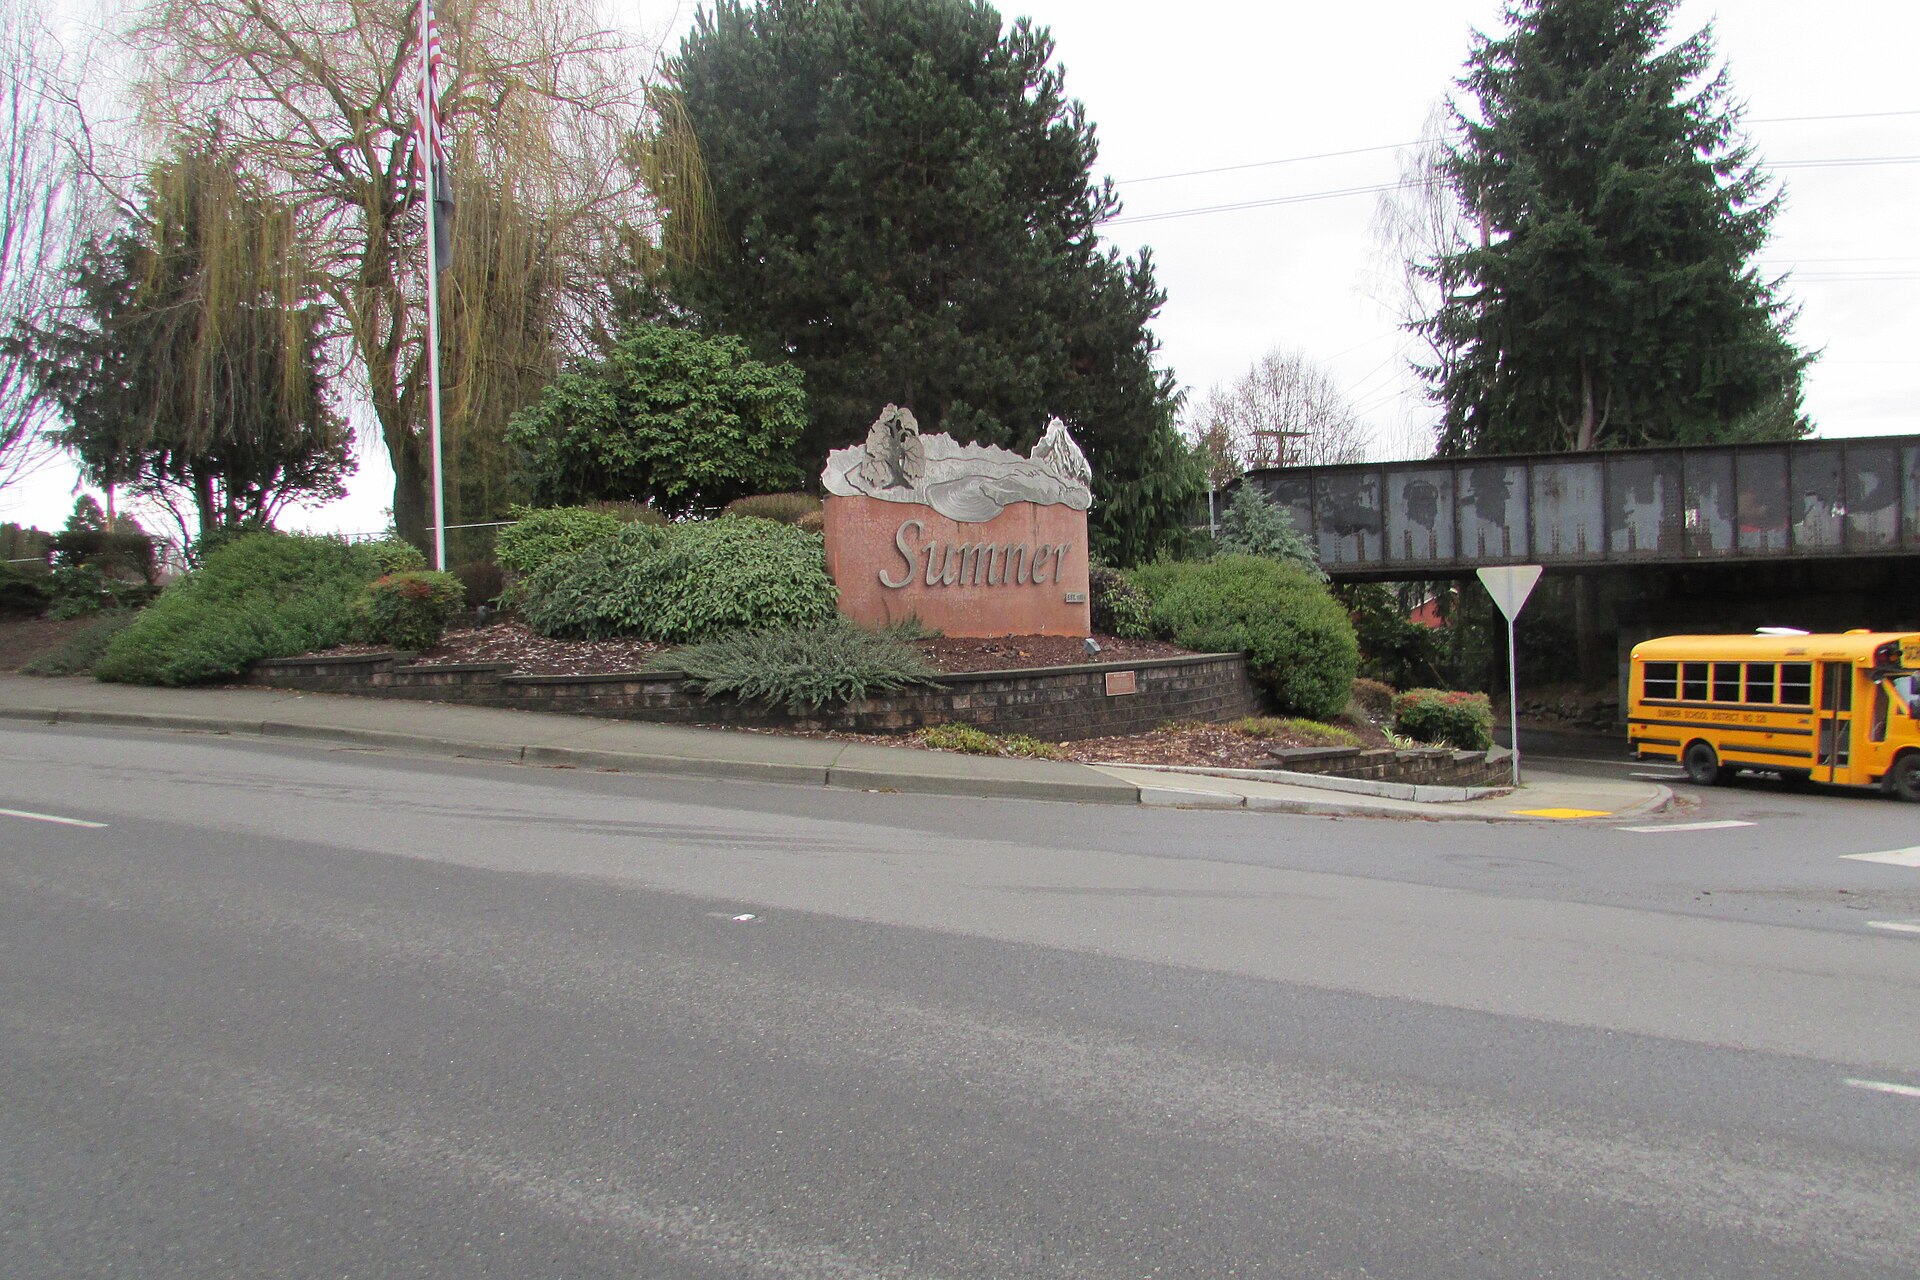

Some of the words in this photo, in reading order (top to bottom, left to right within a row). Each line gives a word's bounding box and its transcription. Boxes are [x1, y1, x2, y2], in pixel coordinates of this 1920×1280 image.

[878, 519, 1072, 589] Sumner
[1657, 708, 1681, 718] SUMNER
[1684, 710, 1709, 720] SCHOOL
[1712, 712, 1739, 722] DISTRICT
